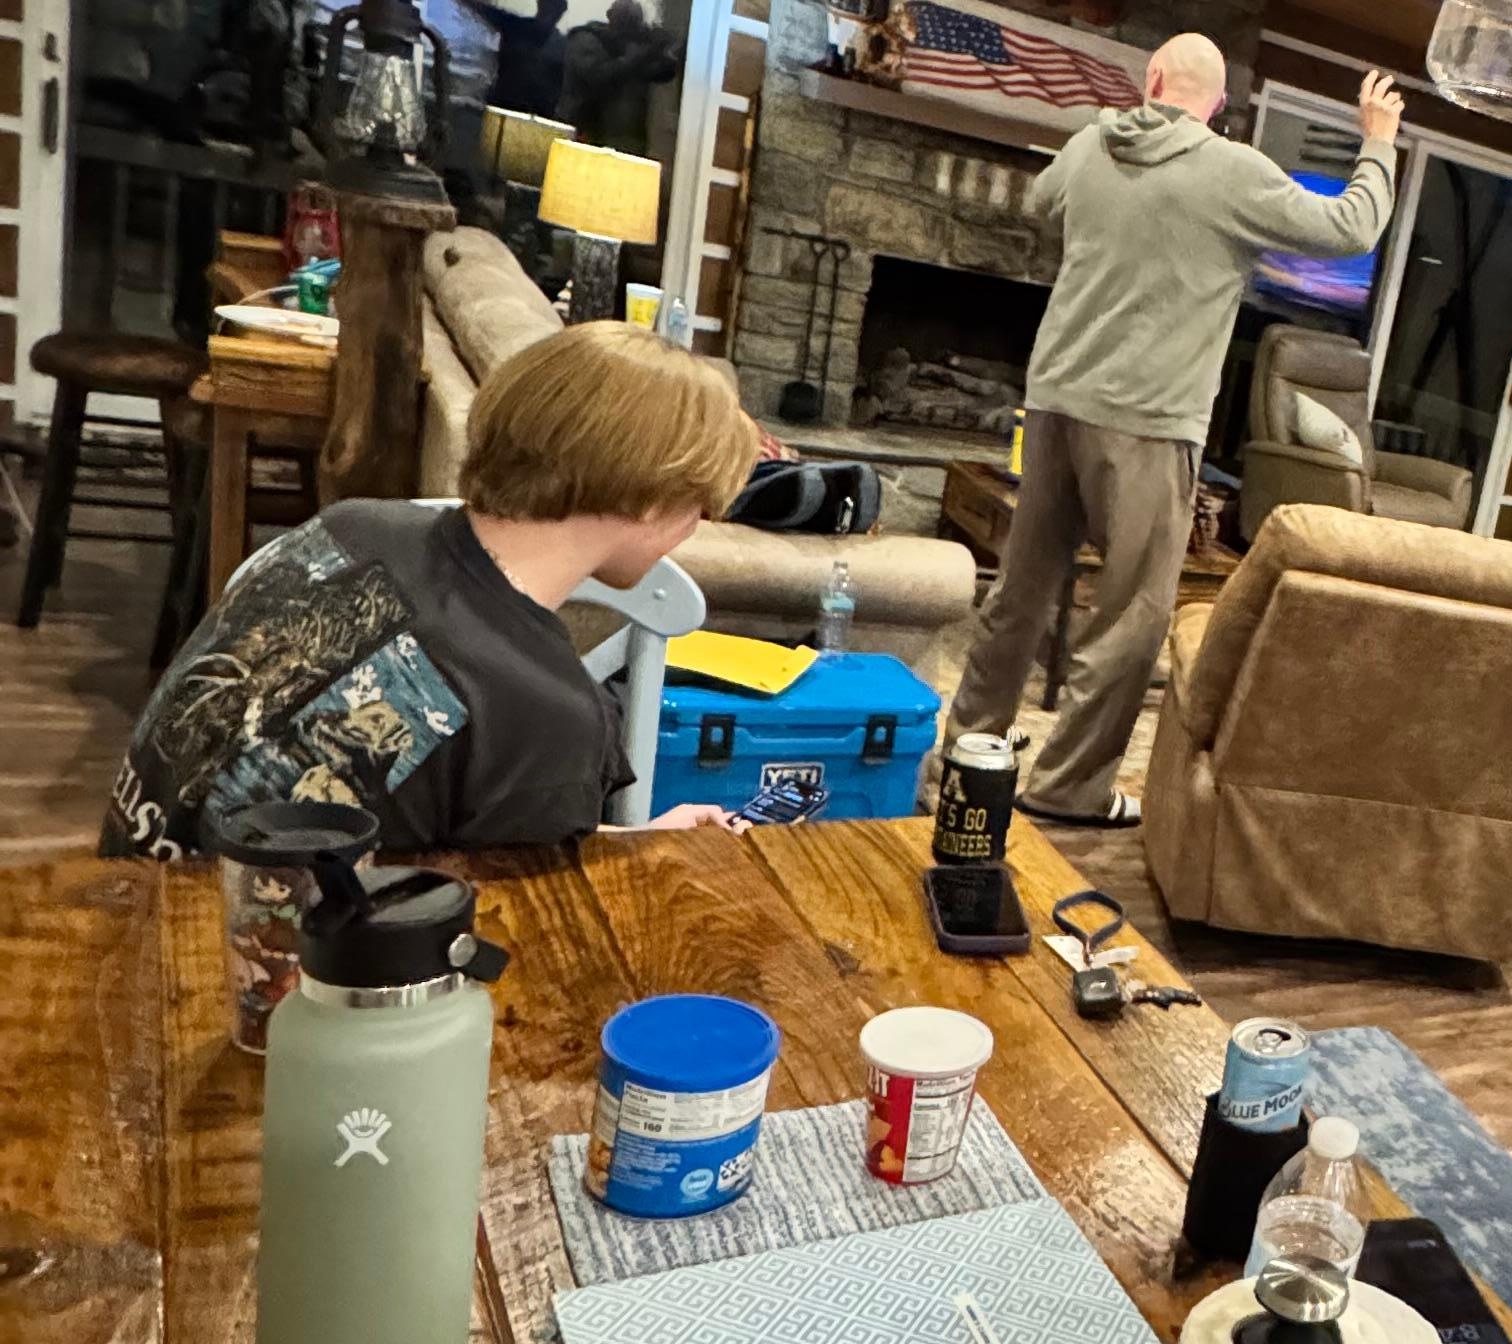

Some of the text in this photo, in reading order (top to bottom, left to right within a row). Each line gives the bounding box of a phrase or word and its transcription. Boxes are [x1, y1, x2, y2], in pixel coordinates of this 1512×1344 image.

[768, 768, 818, 785] YETI
[964, 807, 987, 831] GO
[1221, 1098, 1261, 1118] BLUE
